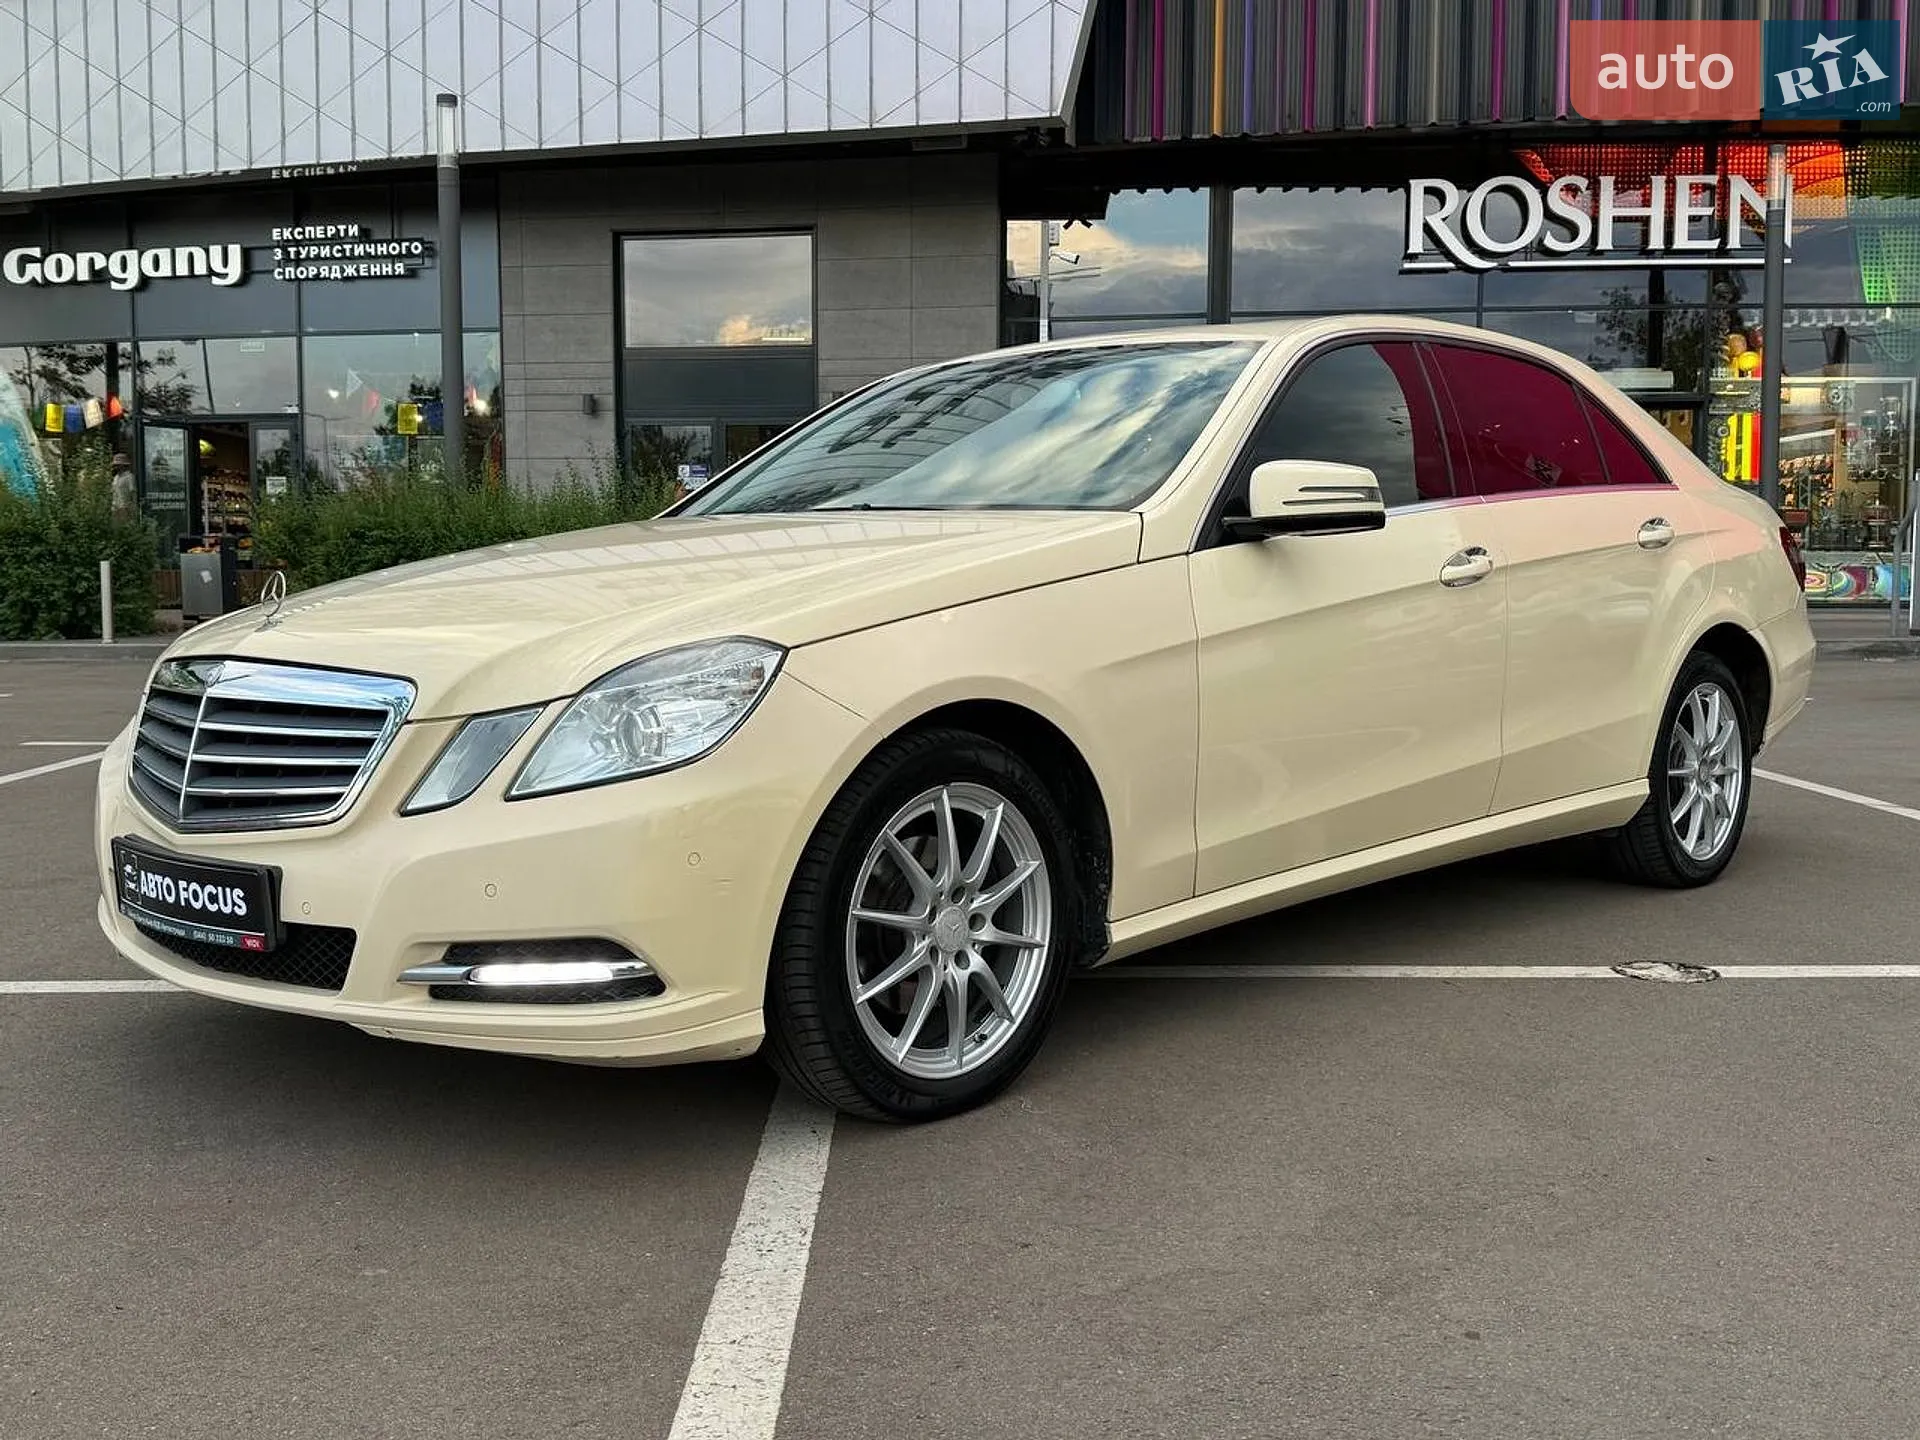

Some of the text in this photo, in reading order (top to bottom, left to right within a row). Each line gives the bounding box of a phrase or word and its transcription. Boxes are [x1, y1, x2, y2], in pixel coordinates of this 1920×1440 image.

[272, 224, 359, 241] ЕКСПЕРТИ
[1408, 175, 1793, 269] ROSHEN
[286, 242, 423, 260] ТУРИСТИЧНОГО
[3, 244, 243, 291] Gorgany
[273, 262, 405, 281] СПОРЯДЖЕННЯ
[140, 870, 248, 916] АВТО FOCUS
